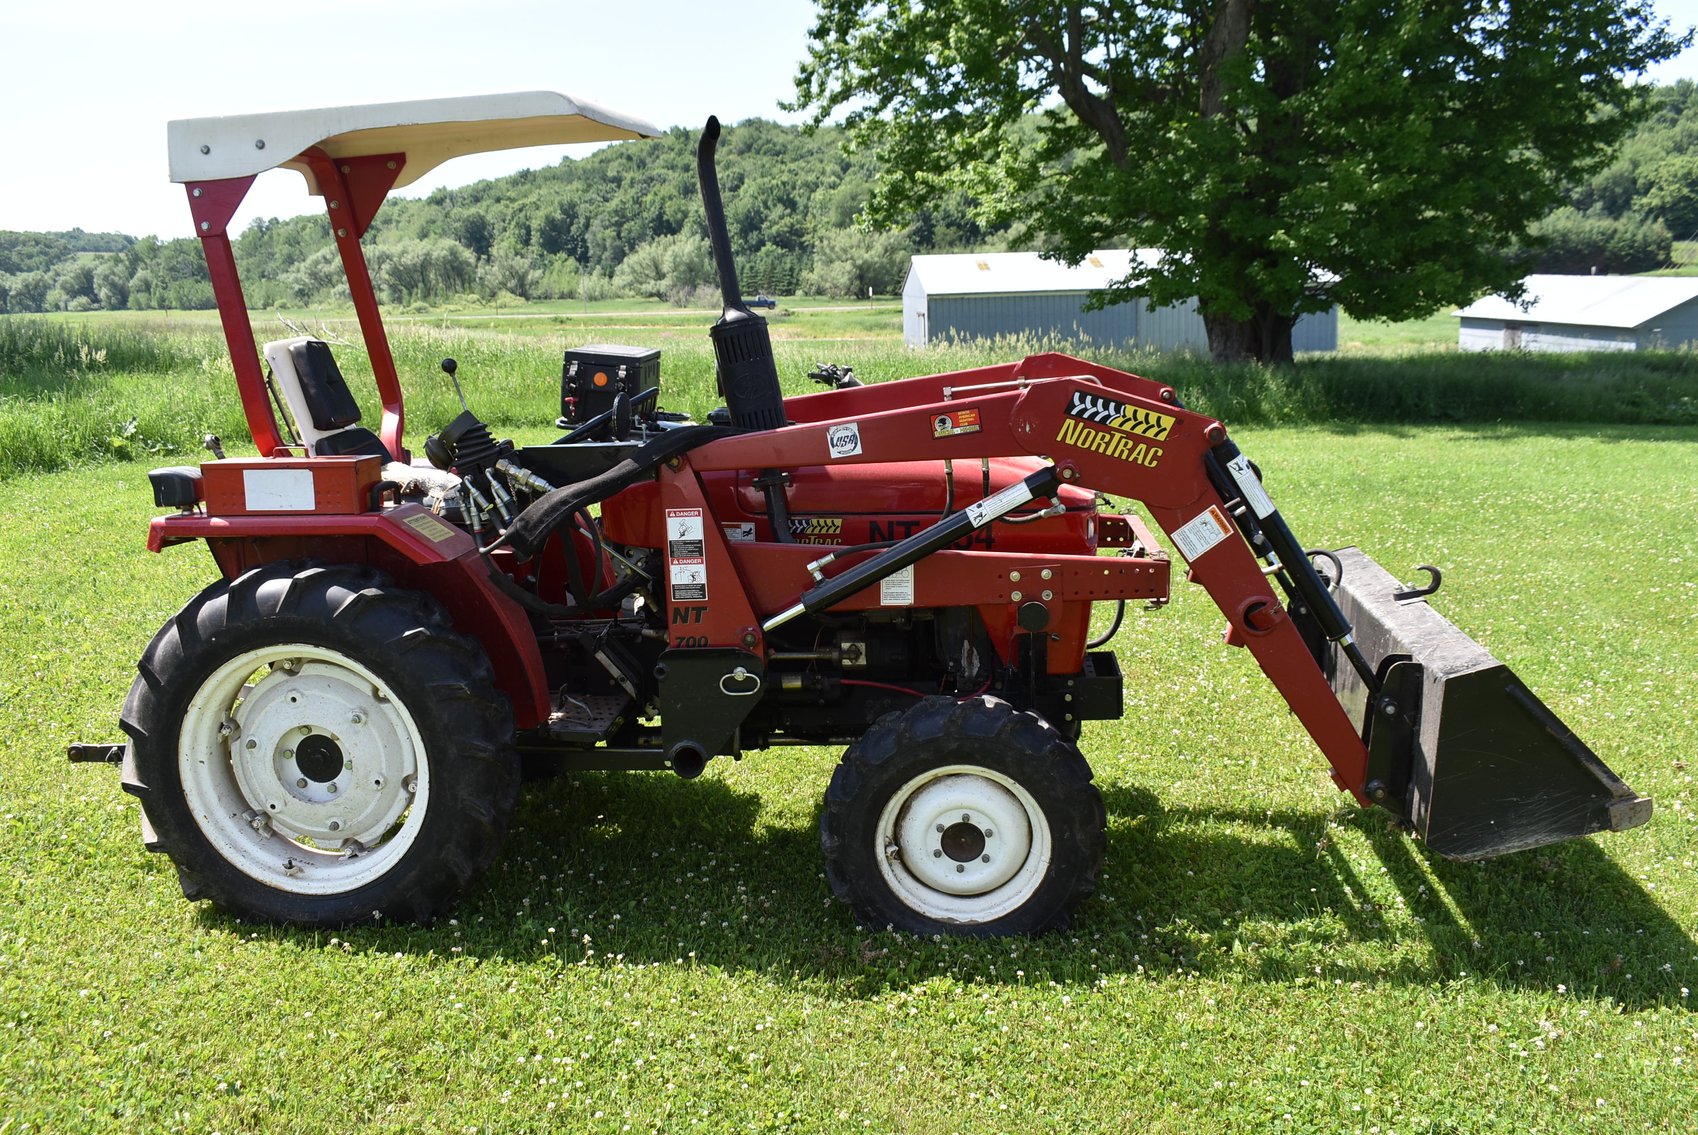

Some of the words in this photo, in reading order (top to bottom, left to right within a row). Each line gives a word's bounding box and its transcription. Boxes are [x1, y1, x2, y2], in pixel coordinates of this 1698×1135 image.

[835, 434, 856, 448] USA
[869, 520, 920, 543] NT
[672, 606, 709, 625] NT
[675, 635, 709, 648] 700
